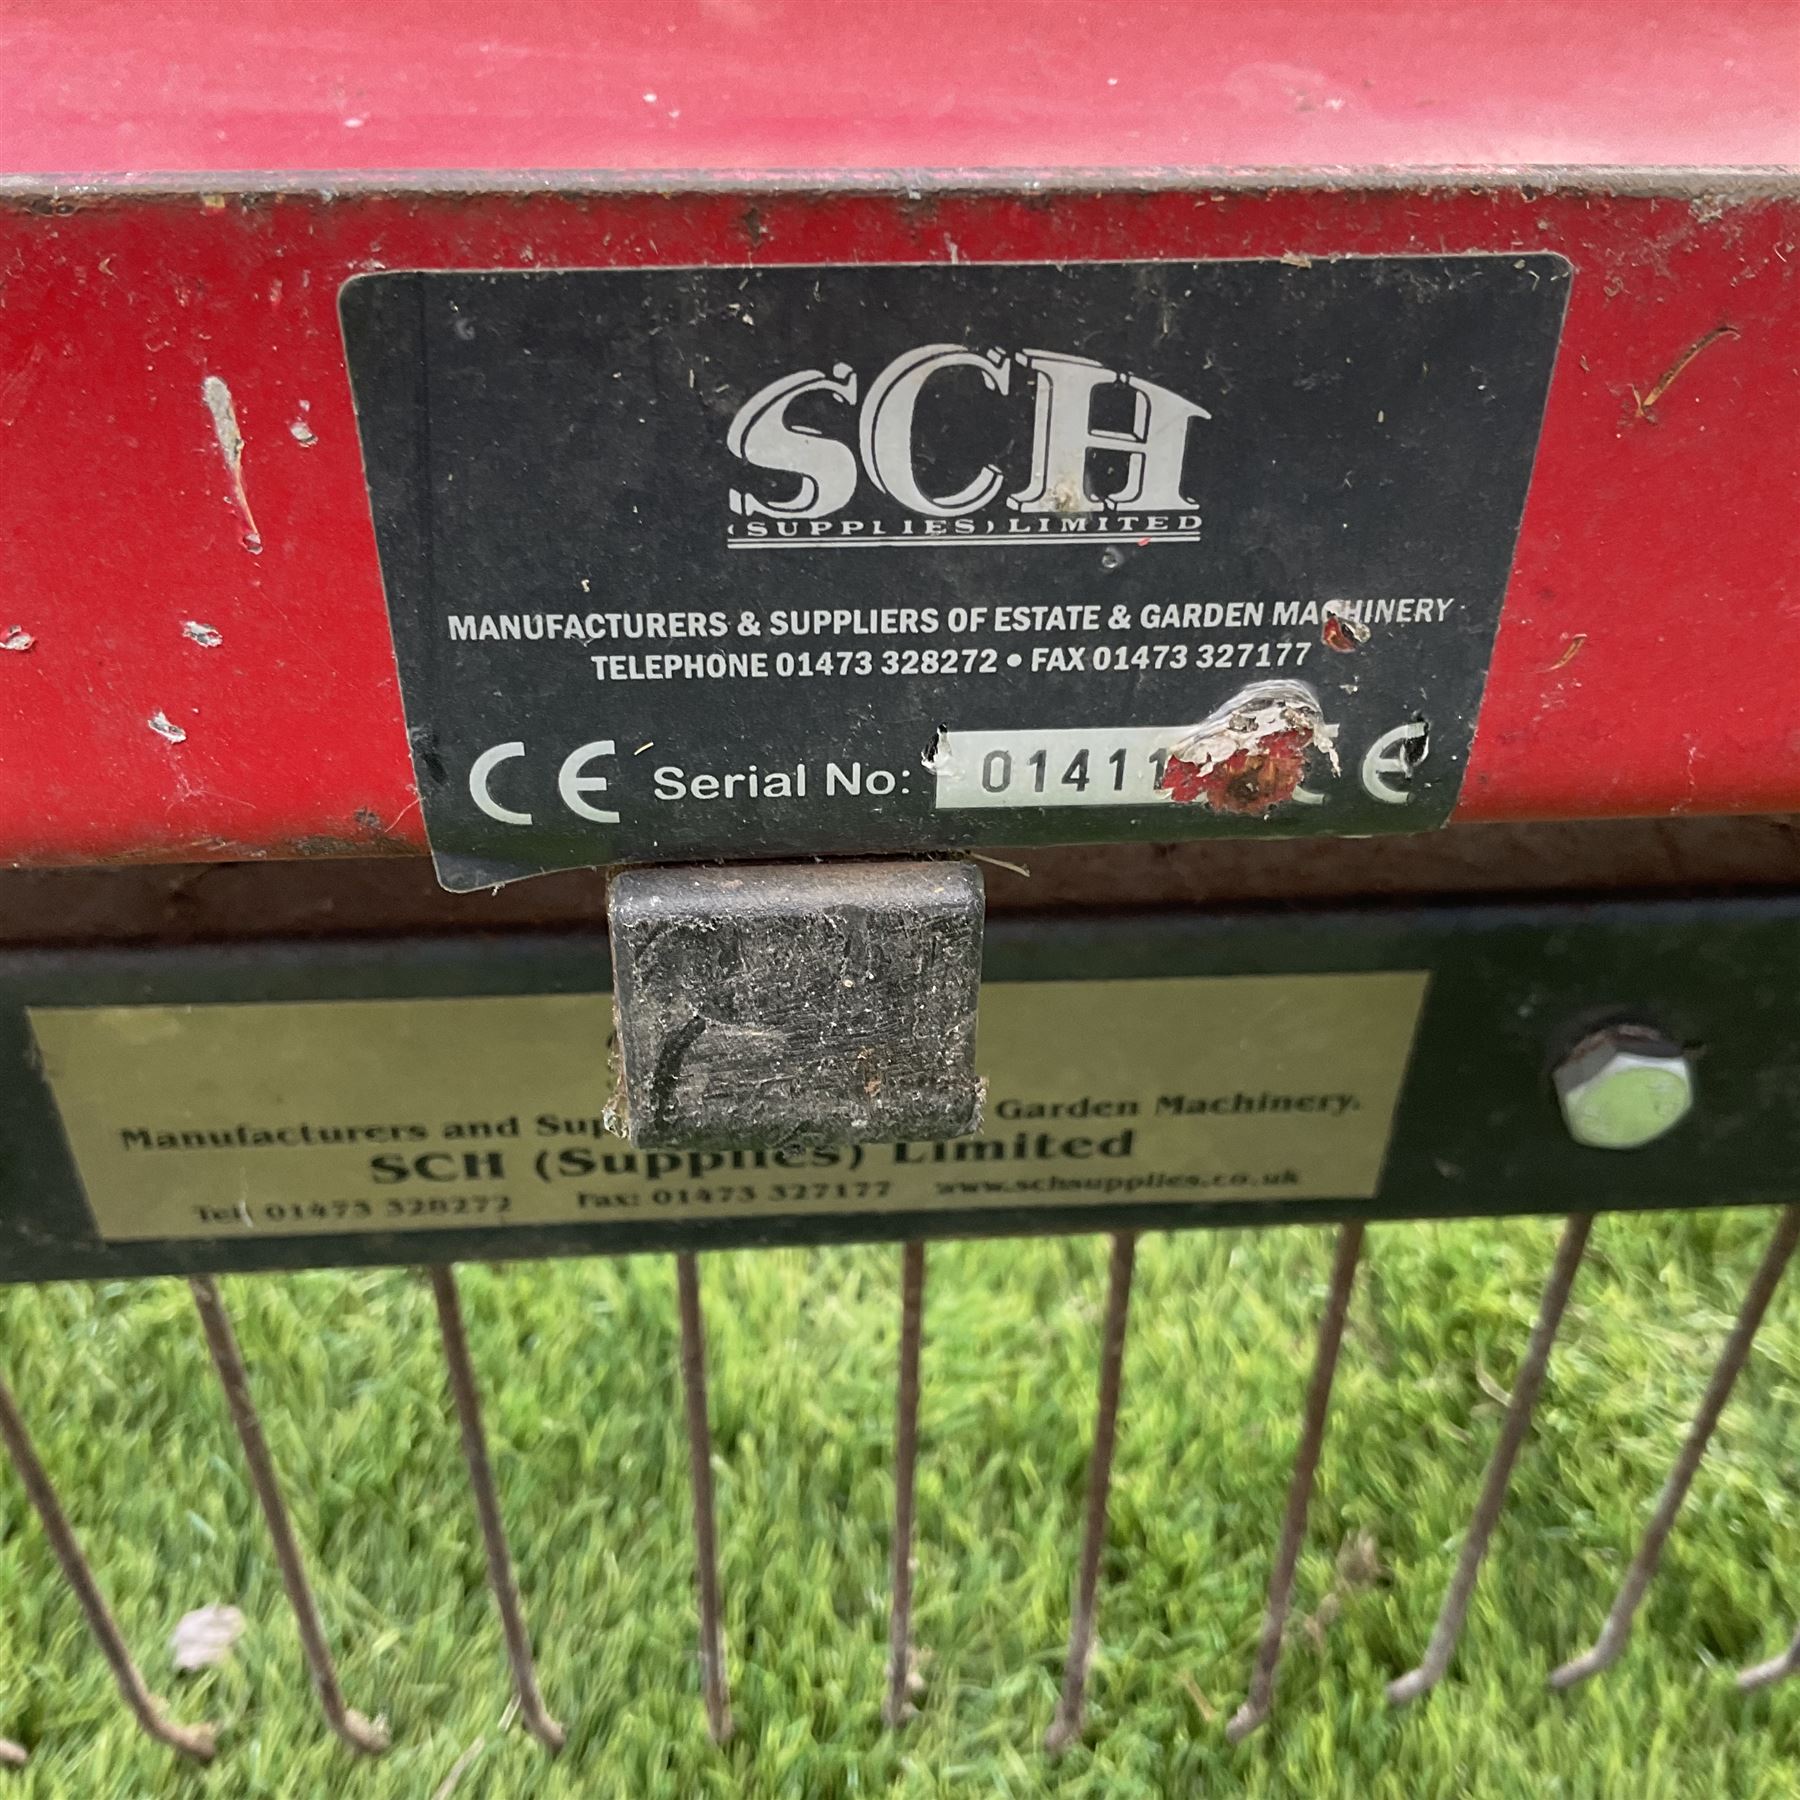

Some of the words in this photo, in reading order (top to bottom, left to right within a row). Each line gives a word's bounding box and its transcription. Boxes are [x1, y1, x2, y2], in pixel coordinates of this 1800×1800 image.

[727, 343, 1212, 519] SCH
[1008, 515, 1202, 533] LIMITED
[448, 612, 728, 641] MANUFACTURERS
[739, 612, 762, 637] &
[769, 607, 939, 635] SUPPLIERS
[948, 606, 986, 633] OF
[994, 604, 1100, 631] ESTATE
[1107, 604, 1132, 629] &
[1141, 602, 1263, 628] GARDEN
[591, 653, 768, 680] TELEPHONE
[776, 650, 873, 677] 01473
[880, 646, 998, 675] 328272
[1031, 645, 1086, 672] FAX
[1092, 644, 1188, 670] 01473
[1195, 642, 1313, 669] 327177
[653, 764, 807, 801] Serial
[826, 763, 911, 796] No:
[121, 1124, 427, 1152] Manufacturers
[442, 1117, 520, 1140] and
[995, 1096, 1140, 1122] Garden
[1155, 1091, 1362, 1118] Machinery.
[371, 1152, 505, 1184] SCH
[893, 1128, 1136, 1164] Limited
[770, 1180, 891, 1201] 327177
[265, 1200, 371, 1220] 01473
